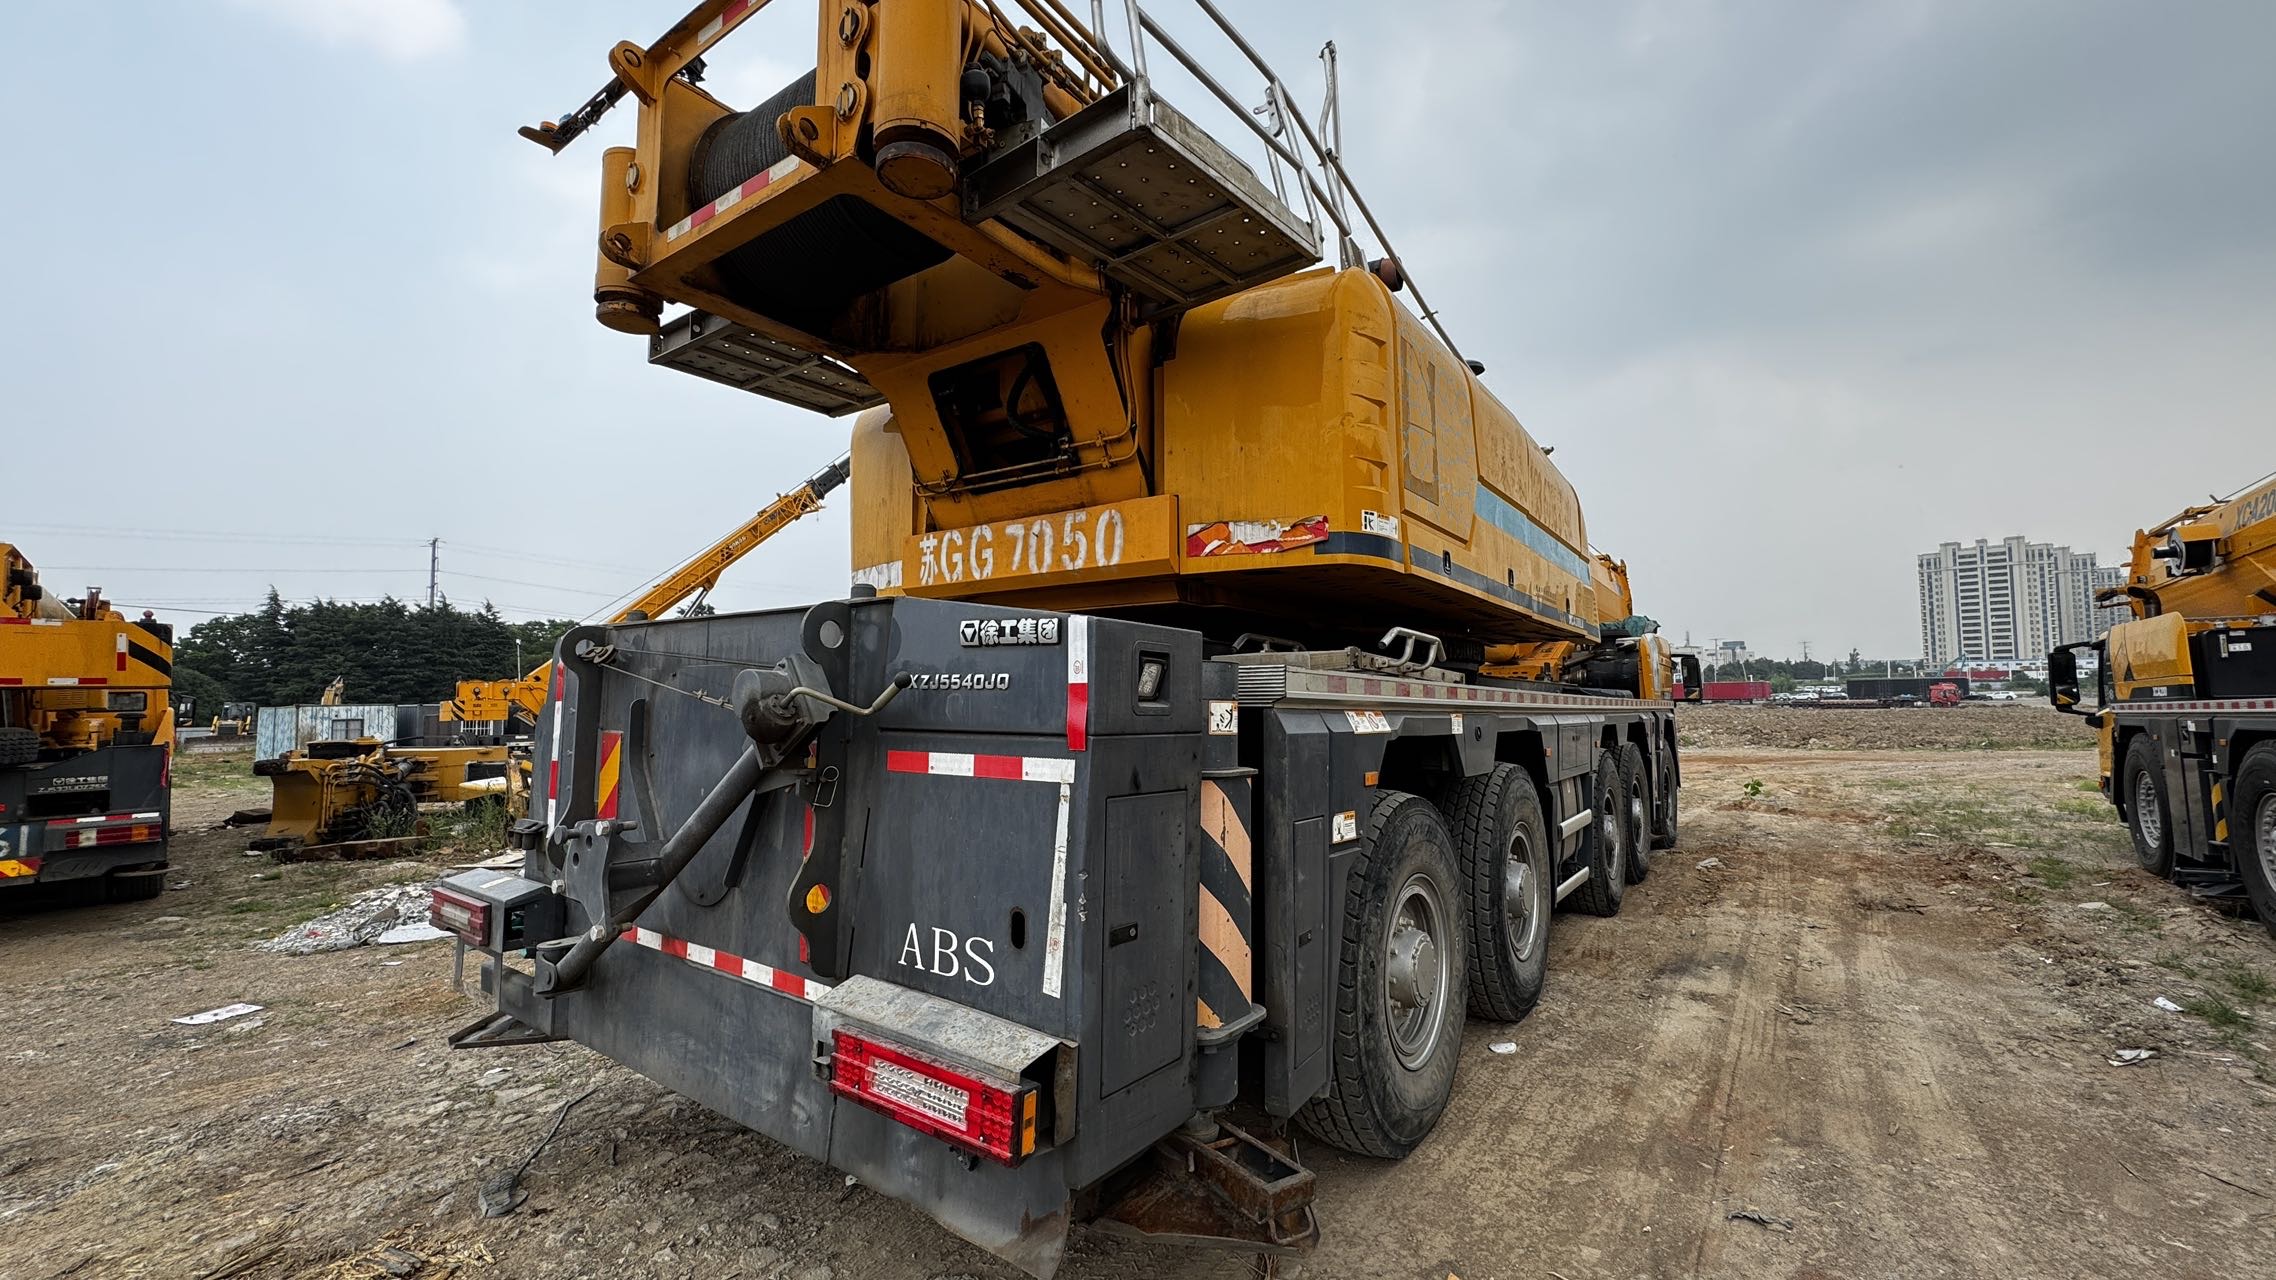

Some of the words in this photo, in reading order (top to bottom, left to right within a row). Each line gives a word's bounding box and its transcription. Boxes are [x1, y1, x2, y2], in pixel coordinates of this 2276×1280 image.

[2233, 488, 2276, 531] XCA20
[980, 617, 1059, 646] 徐工集团
[908, 672, 1010, 691] XZJ5540JQ
[897, 922, 995, 986] ABS
